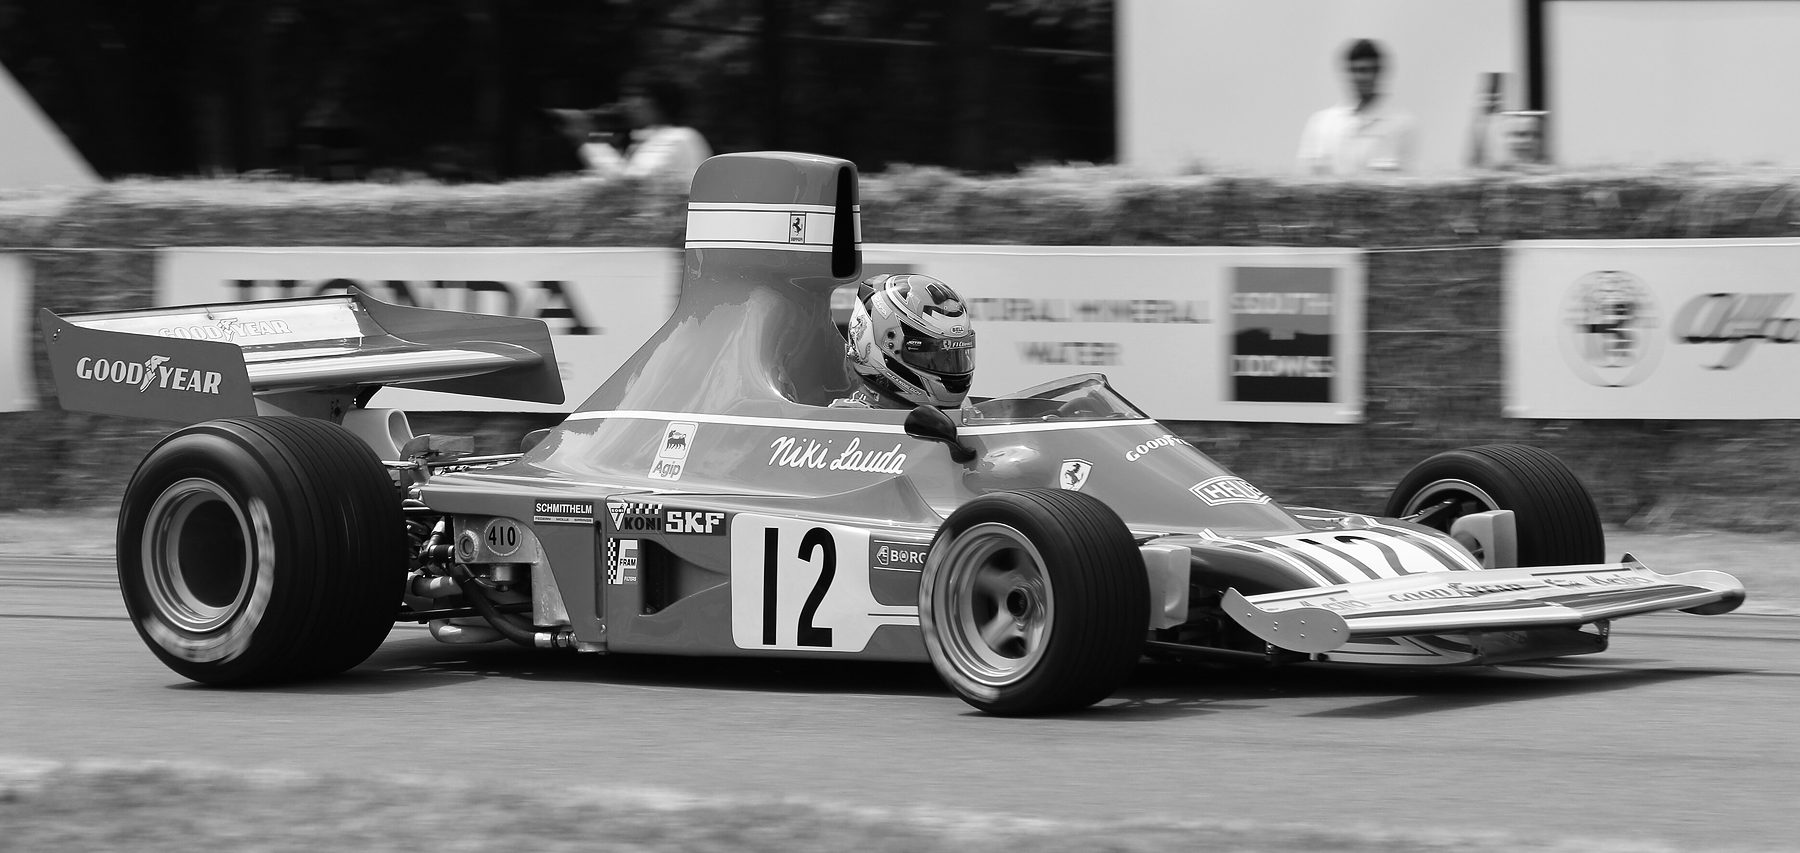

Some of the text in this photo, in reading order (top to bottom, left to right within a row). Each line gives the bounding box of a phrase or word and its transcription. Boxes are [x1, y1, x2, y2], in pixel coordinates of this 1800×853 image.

[829, 437, 907, 475] Lauda
[652, 460, 681, 478] Agip
[535, 502, 593, 514] SCHMITTHELM
[624, 516, 662, 531] KONI
[665, 511, 725, 534] SKF
[488, 525, 516, 546] 410
[620, 558, 636, 566] FRAM
[762, 527, 836, 647] 12
